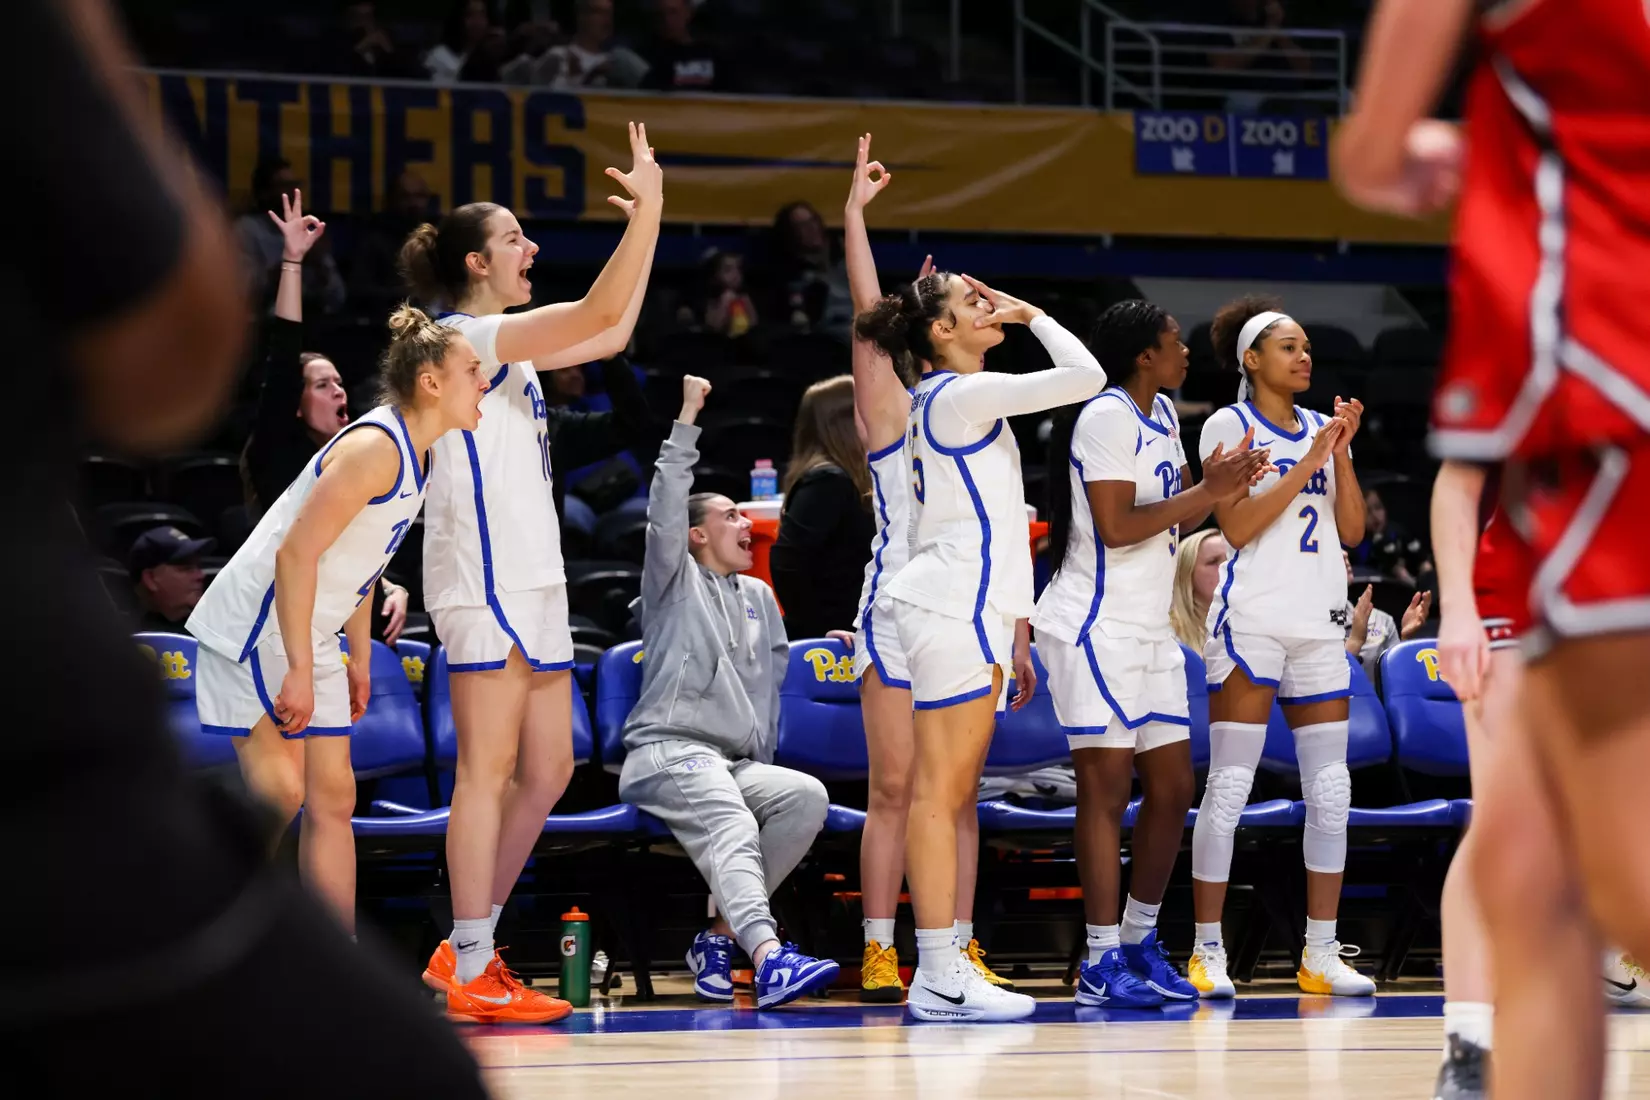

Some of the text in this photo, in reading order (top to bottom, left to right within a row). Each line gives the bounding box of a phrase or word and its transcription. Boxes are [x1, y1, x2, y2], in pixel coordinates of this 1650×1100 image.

[1140, 116, 1225, 142] ZOO D
[1241, 120, 1320, 146] ZOO E
[1154, 460, 1183, 499] Pit
[1272, 458, 1328, 496] Ptt
[1299, 504, 1319, 553] 2
[560, 935, 576, 957] G
